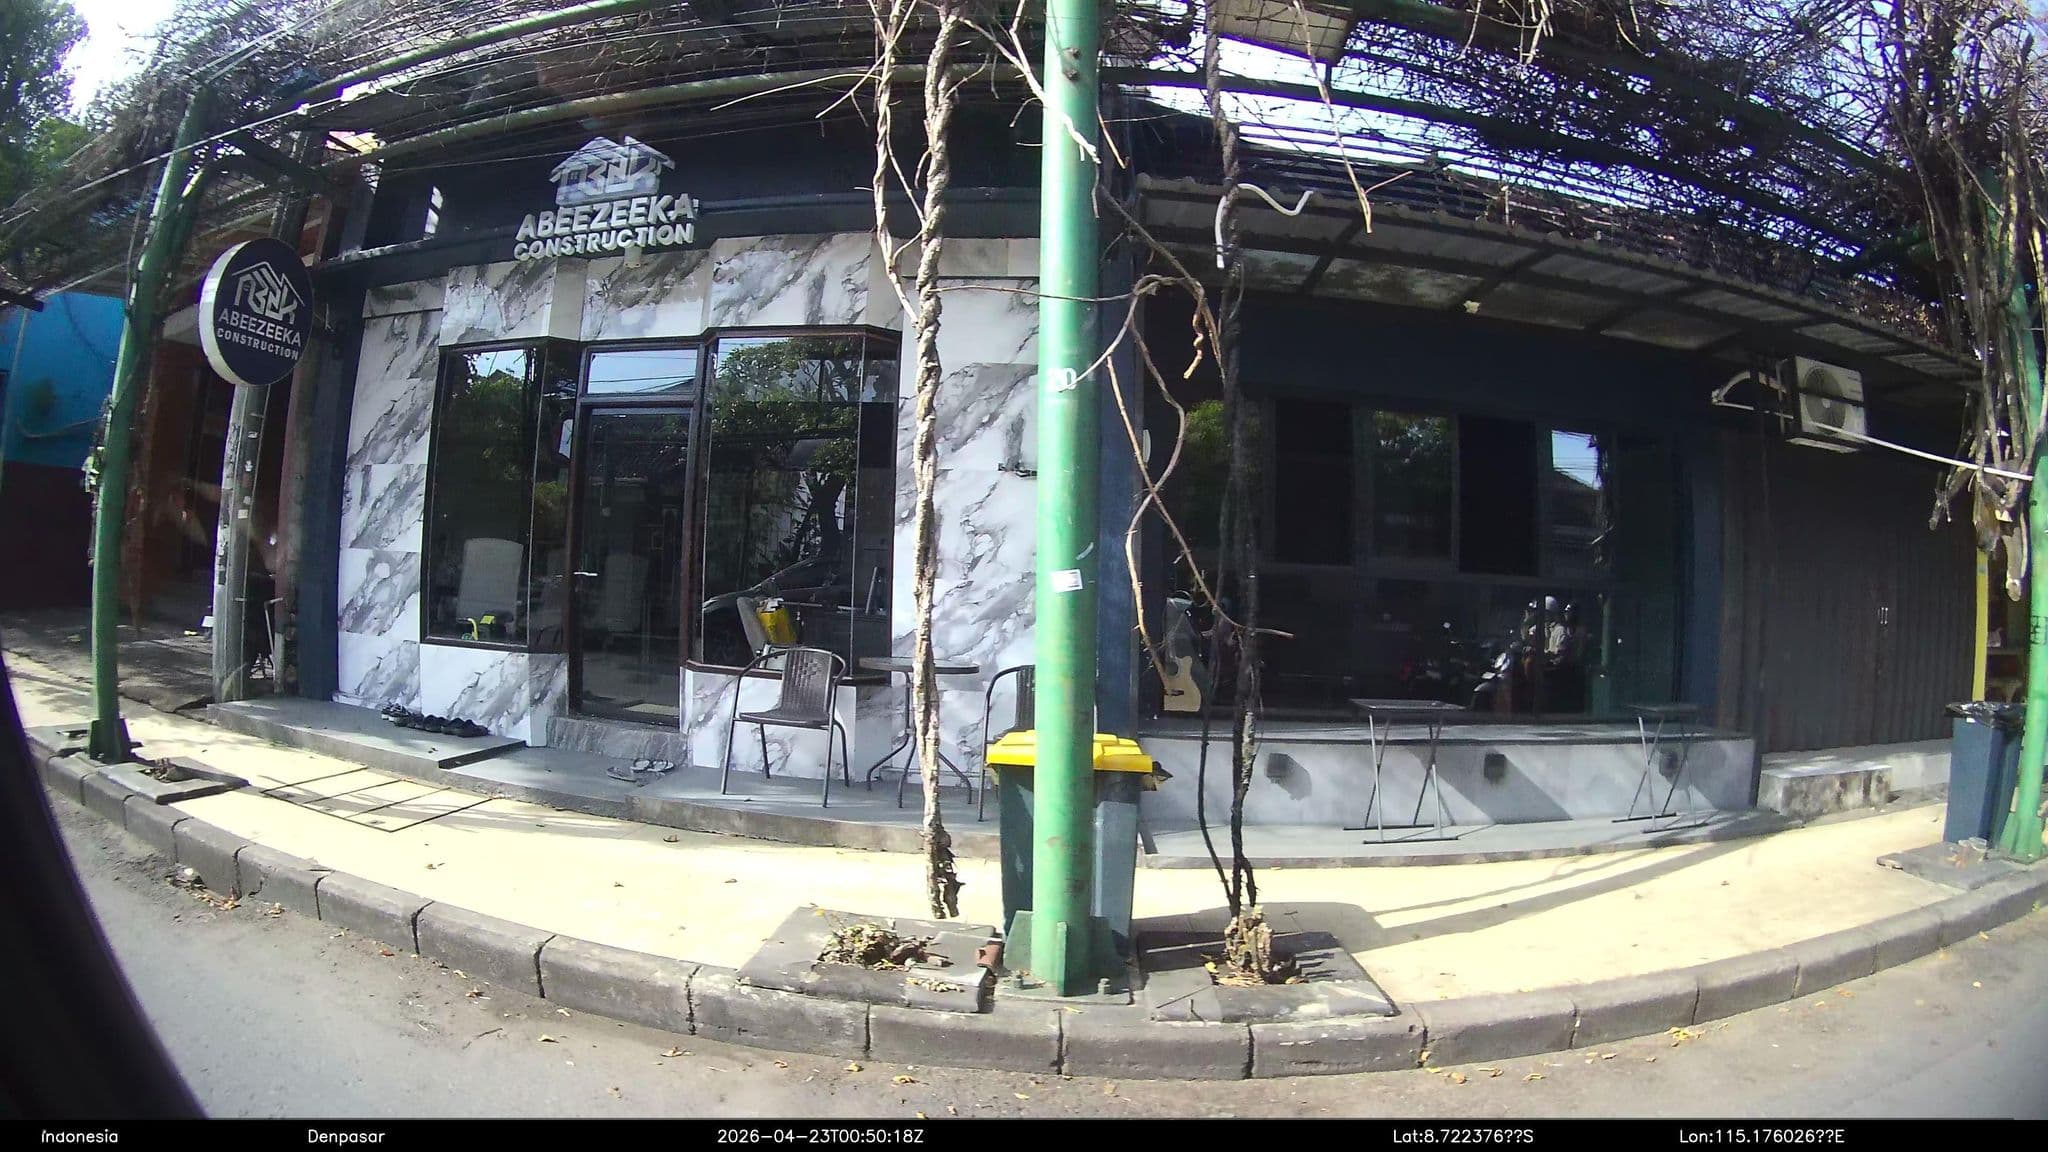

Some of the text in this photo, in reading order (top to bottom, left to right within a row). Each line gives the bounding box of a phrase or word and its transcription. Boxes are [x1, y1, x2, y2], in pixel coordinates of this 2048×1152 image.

[515, 193, 697, 241] ABEEZEEKA
[513, 223, 695, 262] CONSTRUCTION
[216, 327, 299, 360] CONSTRUCTION
[218, 308, 301, 347] ABEEZEEKA
